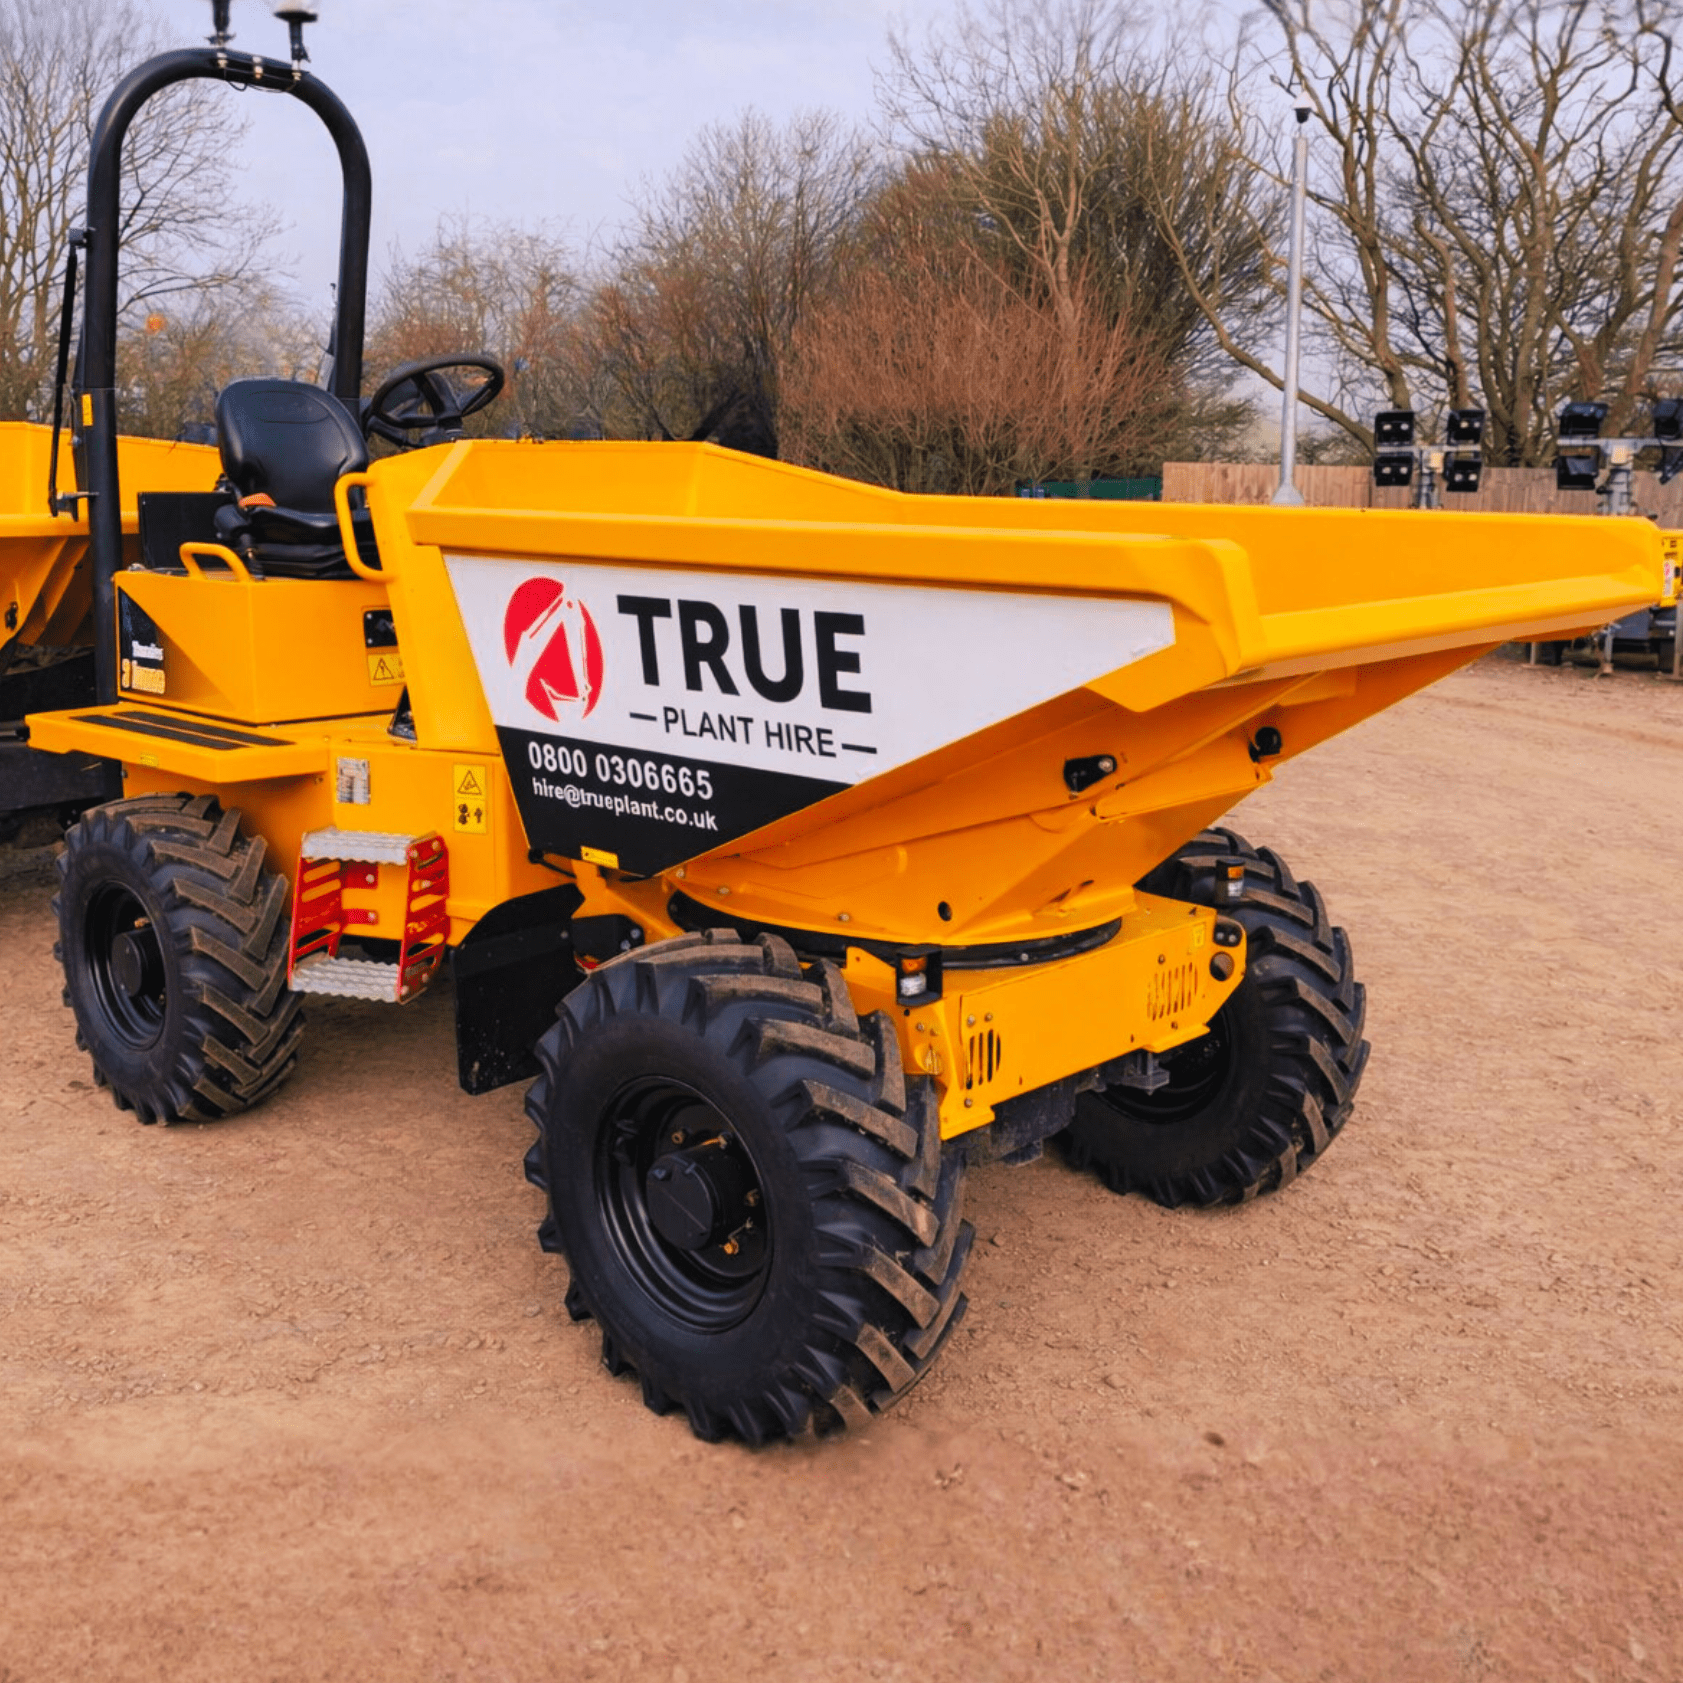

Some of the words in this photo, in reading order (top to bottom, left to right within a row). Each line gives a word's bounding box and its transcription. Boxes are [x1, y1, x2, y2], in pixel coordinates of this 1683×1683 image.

[617, 595, 872, 714] TRUE
[664, 706, 754, 745] PLANT
[765, 722, 837, 758] HIRE
[528, 740, 587, 778] 0800
[595, 757, 713, 800] 0306665
[532, 777, 718, 831] hire@trueplant.co.uk
